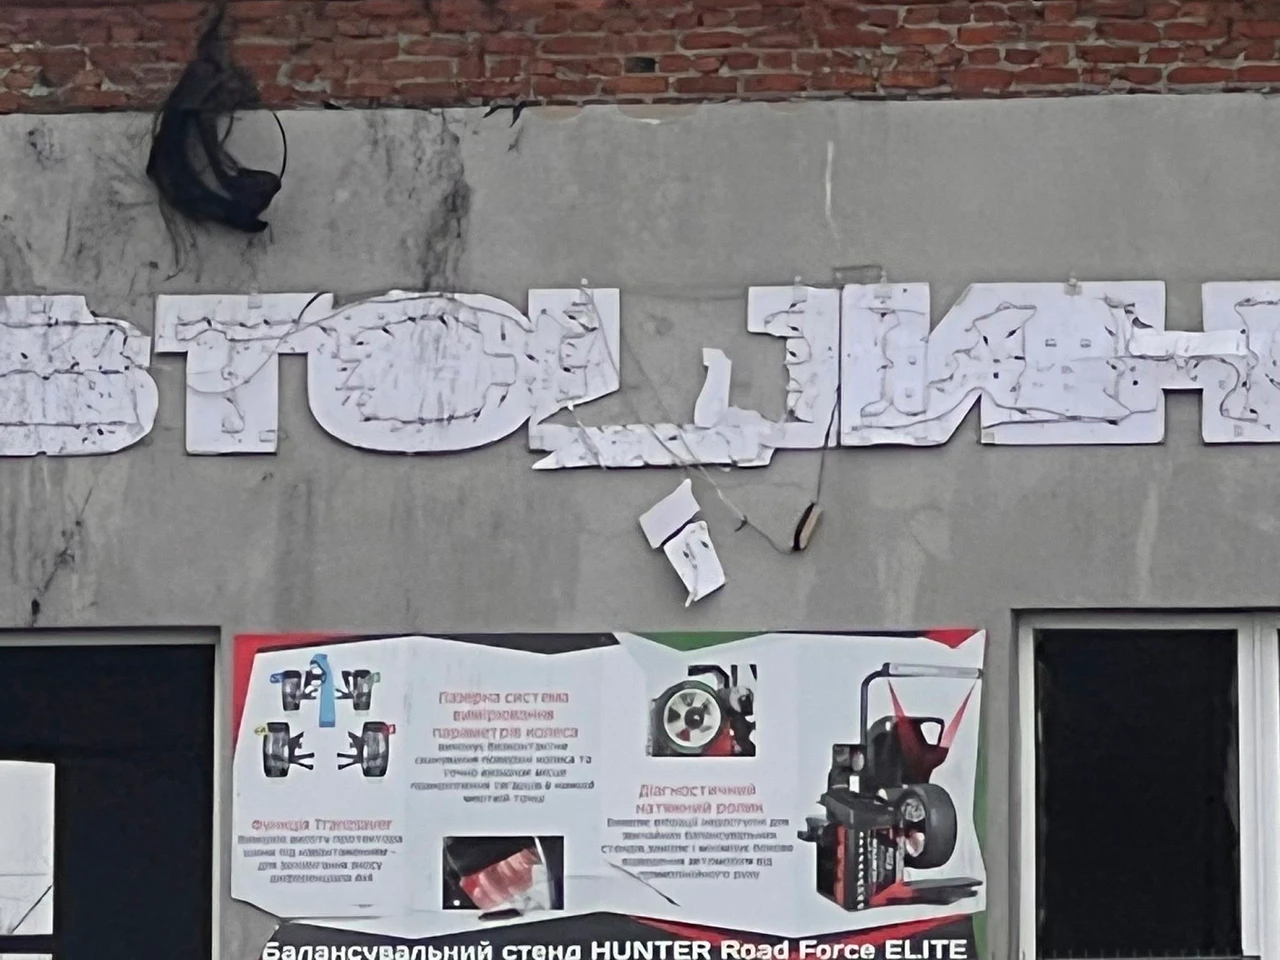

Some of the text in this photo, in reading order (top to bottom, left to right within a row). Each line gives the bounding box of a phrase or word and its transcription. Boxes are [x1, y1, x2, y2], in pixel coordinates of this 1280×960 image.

[262, 940, 969, 960] Балансувальний стенд HUNTER Road Force ELITE
